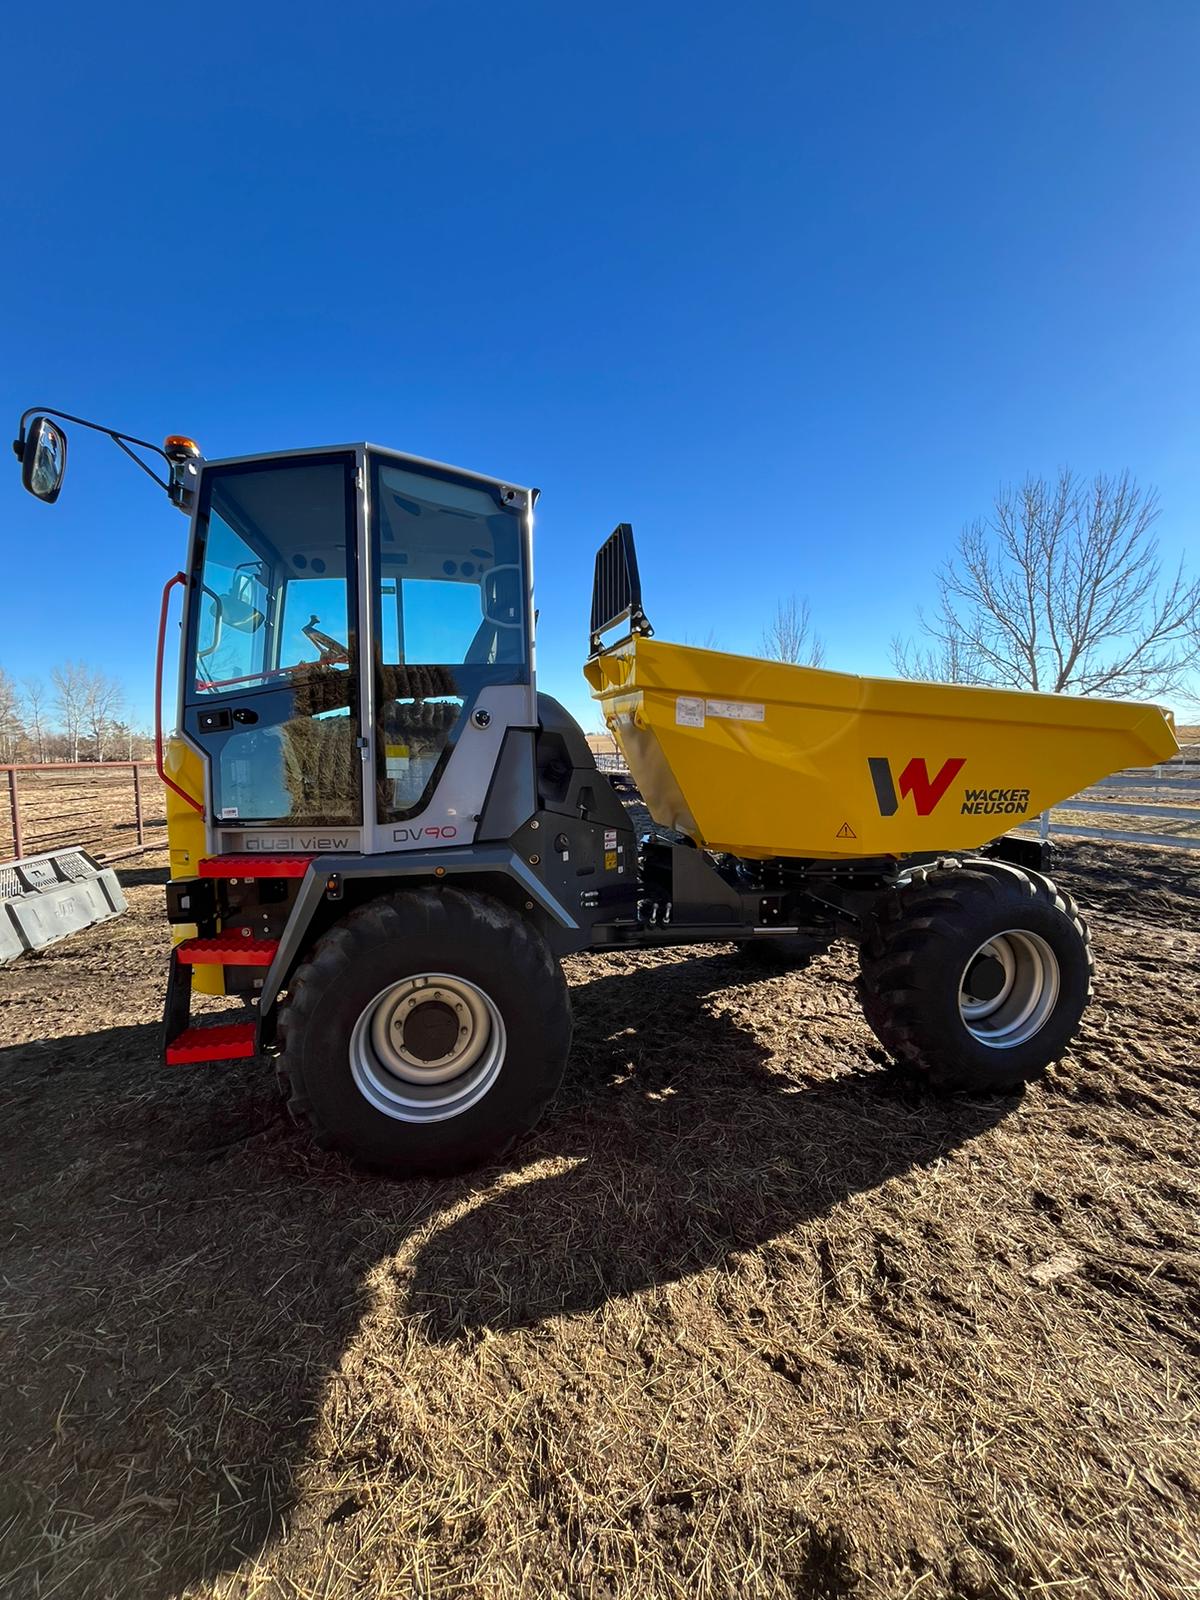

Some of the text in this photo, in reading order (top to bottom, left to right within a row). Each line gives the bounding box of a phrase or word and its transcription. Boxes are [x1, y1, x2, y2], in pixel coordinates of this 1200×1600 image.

[964, 789, 1030, 802] WACKER
[960, 802, 1028, 815] NEUSON
[393, 826, 457, 842] DV90
[246, 836, 349, 850] dual view
